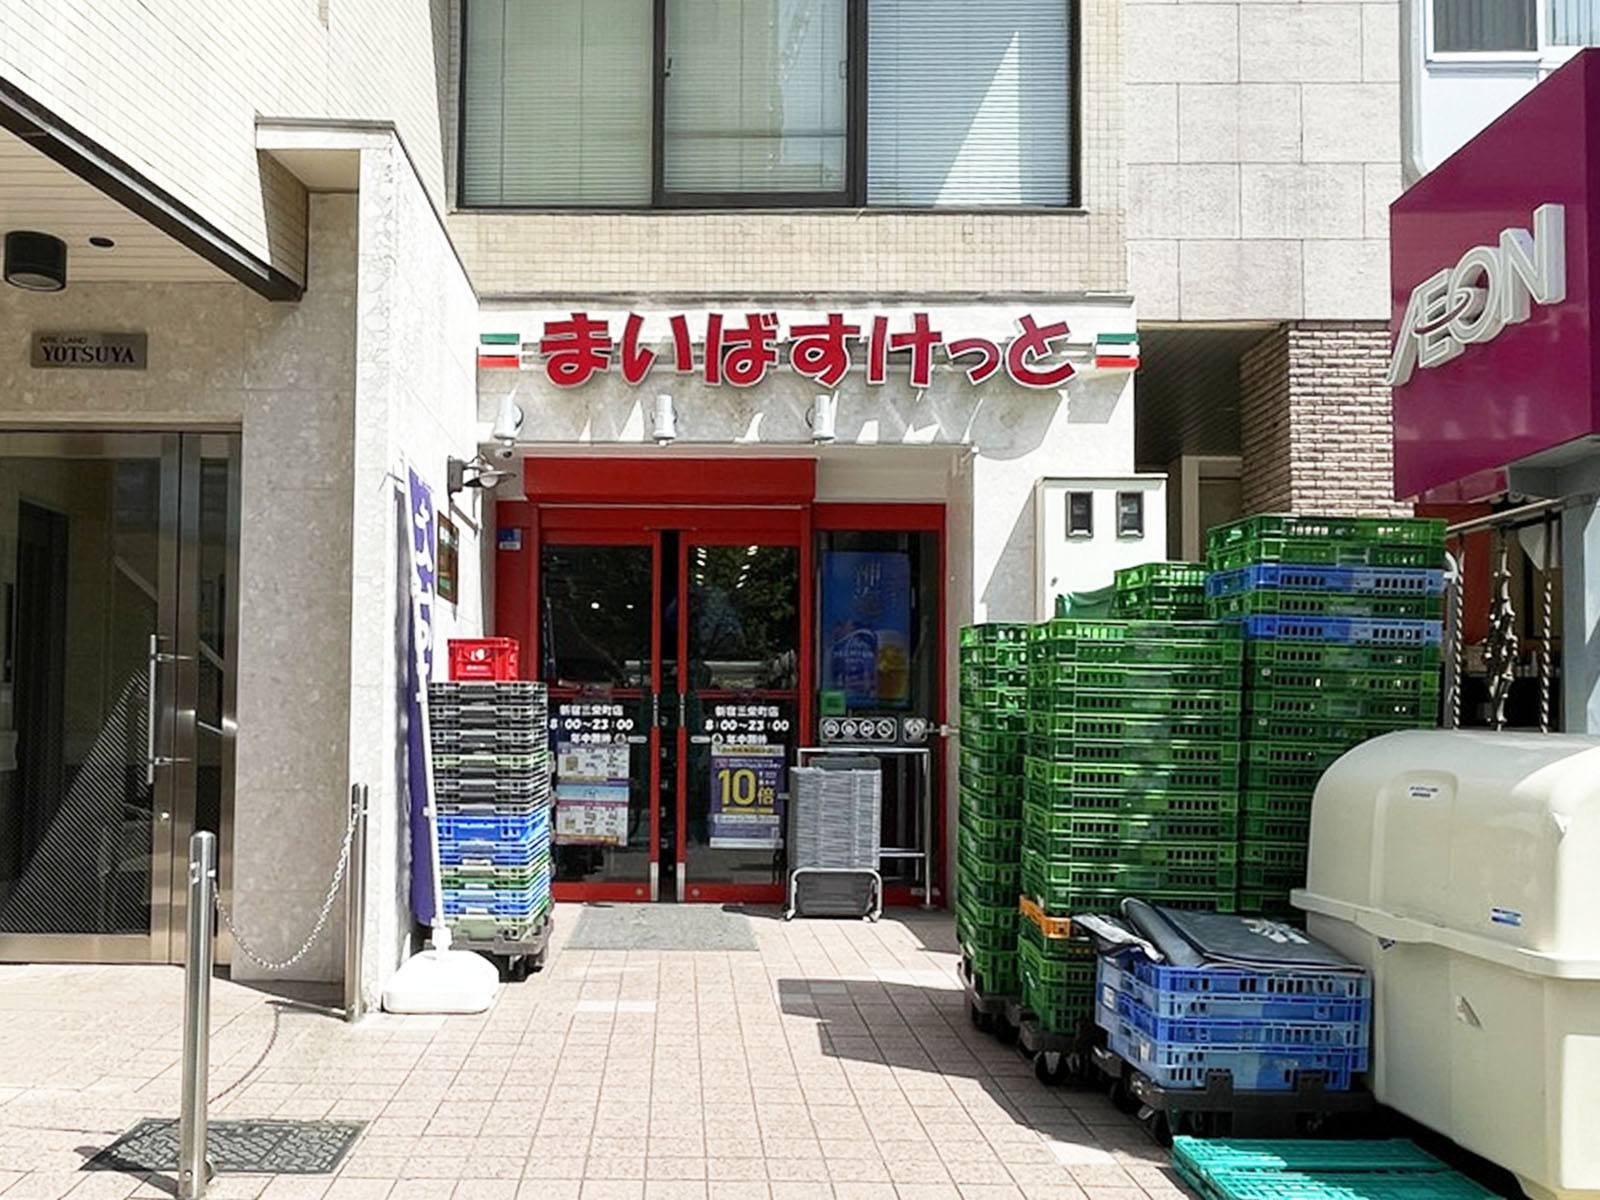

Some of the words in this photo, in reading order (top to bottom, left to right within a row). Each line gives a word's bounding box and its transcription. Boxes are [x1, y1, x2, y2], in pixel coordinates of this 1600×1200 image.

[1386, 203, 1566, 386] AEON
[42, 346, 135, 363] YOTSUYA
[539, 311, 1077, 389] まいばすけっと
